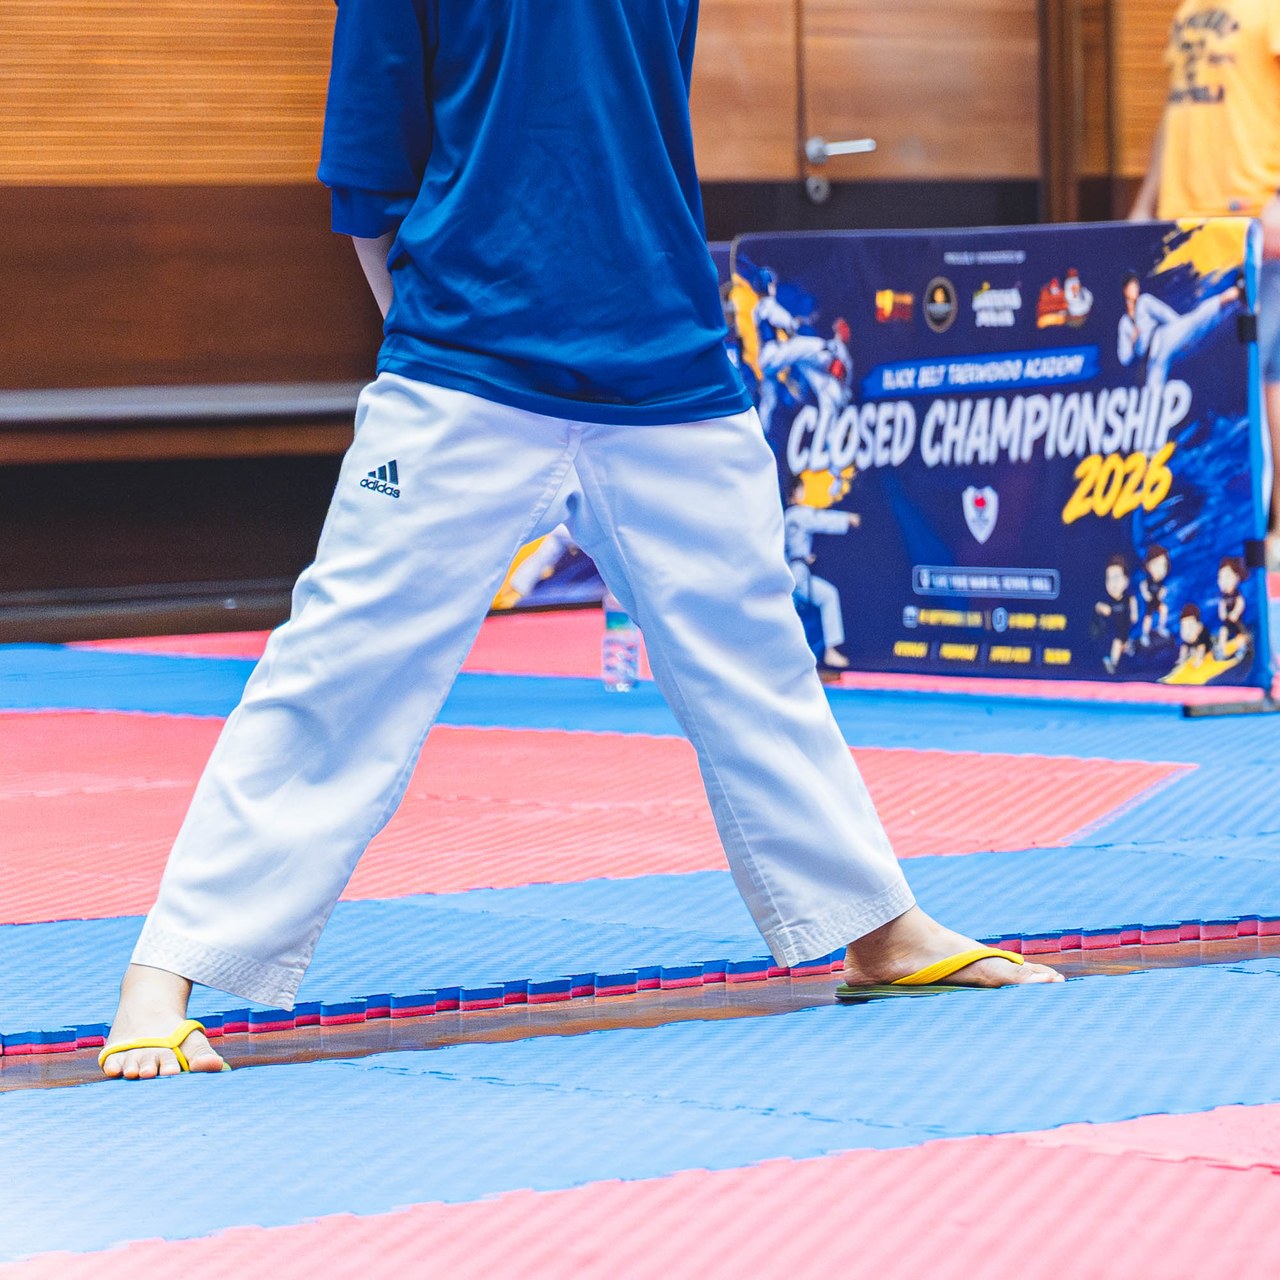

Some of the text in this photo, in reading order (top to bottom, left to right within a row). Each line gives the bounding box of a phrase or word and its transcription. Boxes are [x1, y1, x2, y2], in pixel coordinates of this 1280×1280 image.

[1023, 354, 1084, 379] ACADEMY
[787, 379, 1192, 475] CLOSED CHAMPIONSHIP
[360, 478, 401, 499] adidas
[1062, 440, 1176, 524] 2026
